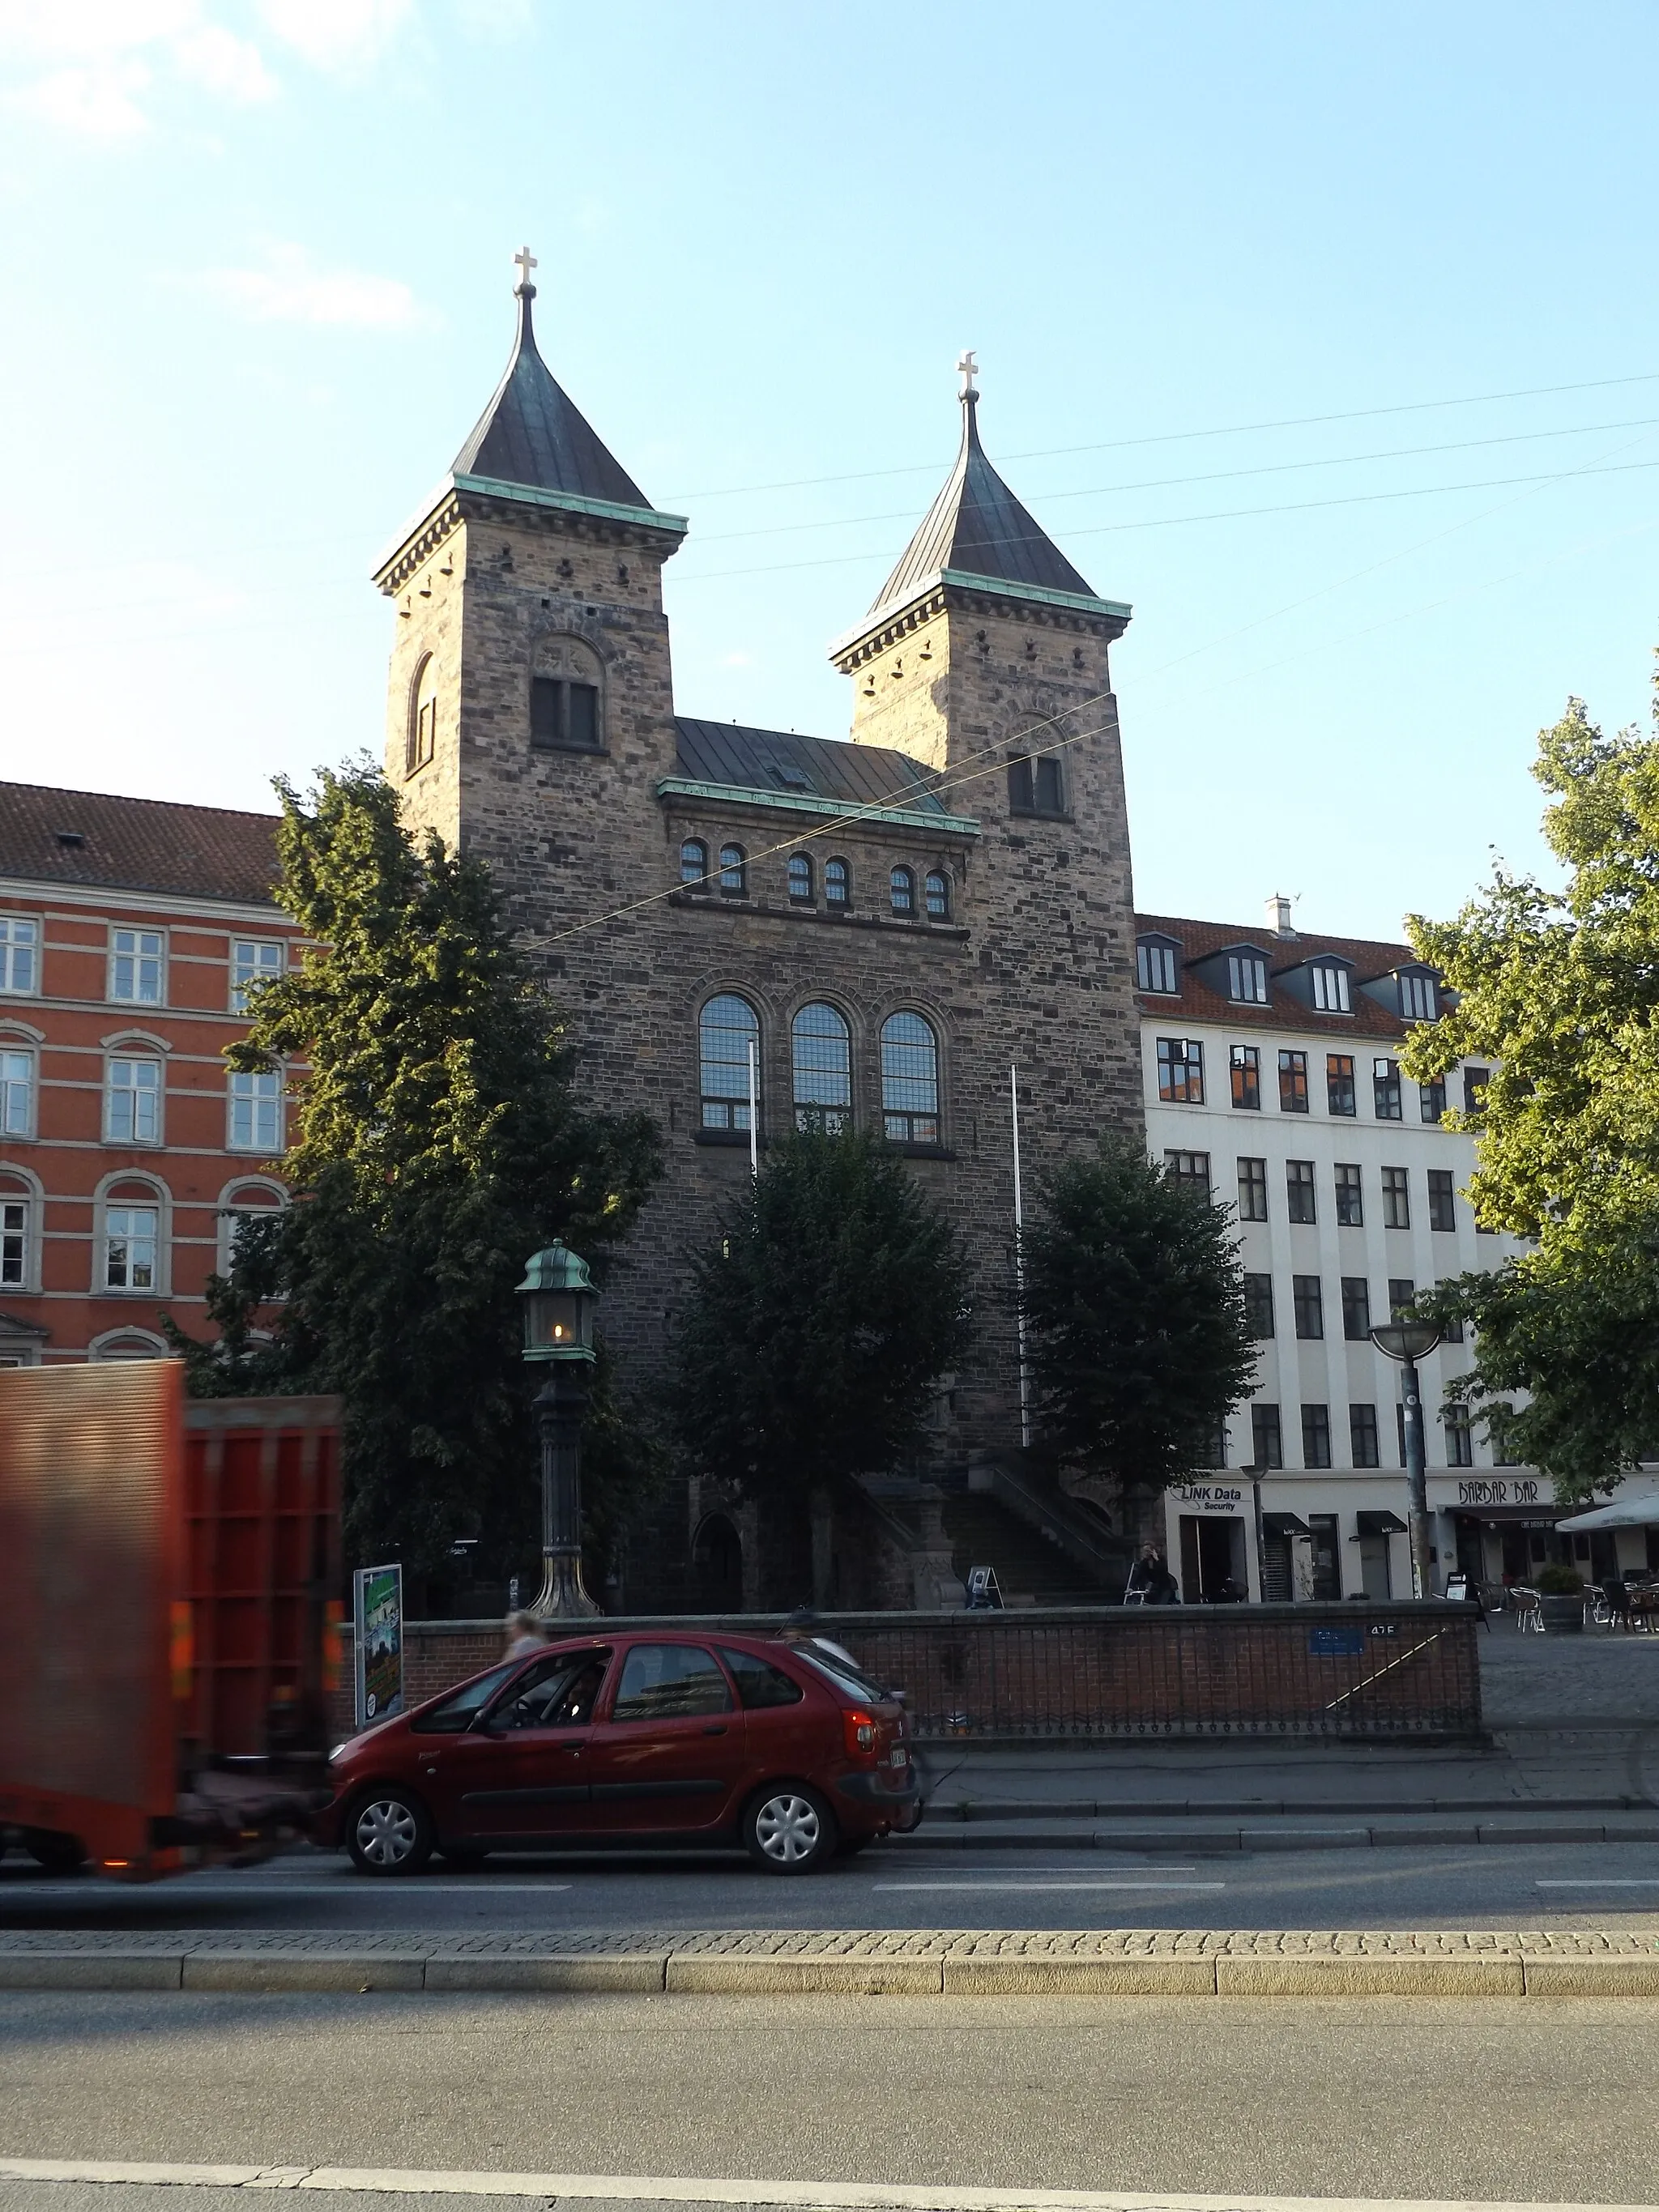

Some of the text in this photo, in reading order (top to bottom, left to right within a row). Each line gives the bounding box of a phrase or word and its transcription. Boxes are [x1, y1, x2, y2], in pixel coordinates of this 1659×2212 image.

[1181, 1485, 1241, 1500] LINK Data
[1458, 1481, 1538, 1504] BARBAR BAR
[1204, 1502, 1235, 1512] Security
